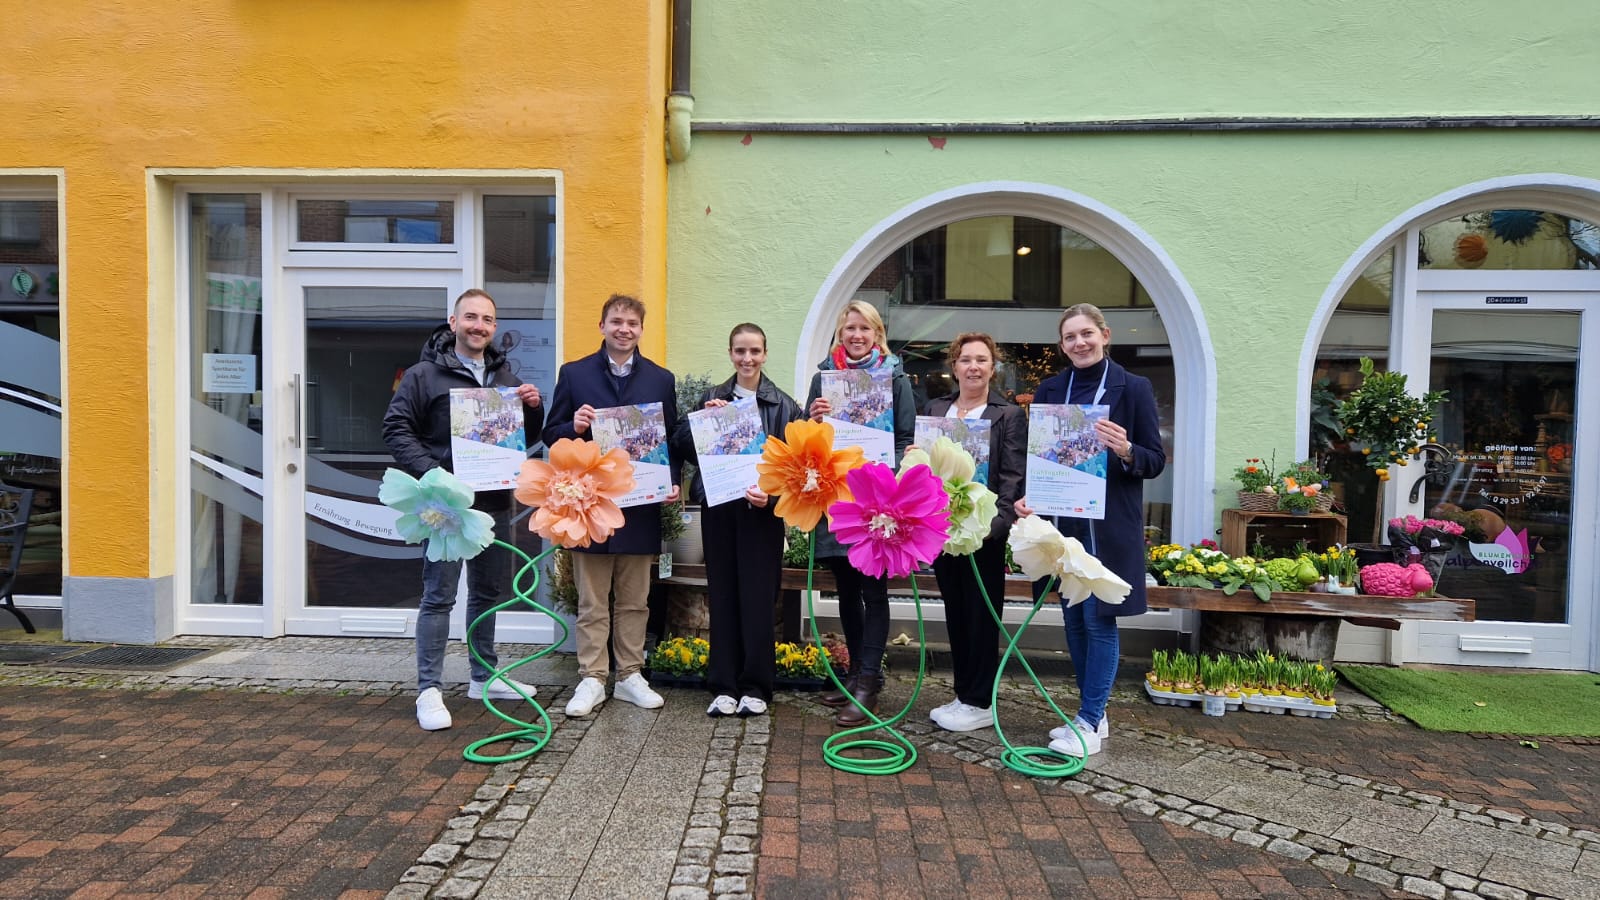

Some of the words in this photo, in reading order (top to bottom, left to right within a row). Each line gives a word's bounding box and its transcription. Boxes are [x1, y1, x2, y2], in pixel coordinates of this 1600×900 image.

[1485, 444, 1518, 453] geöffnet
[313, 503, 351, 526] Ernährung
[355, 519, 393, 536] Bewegung
